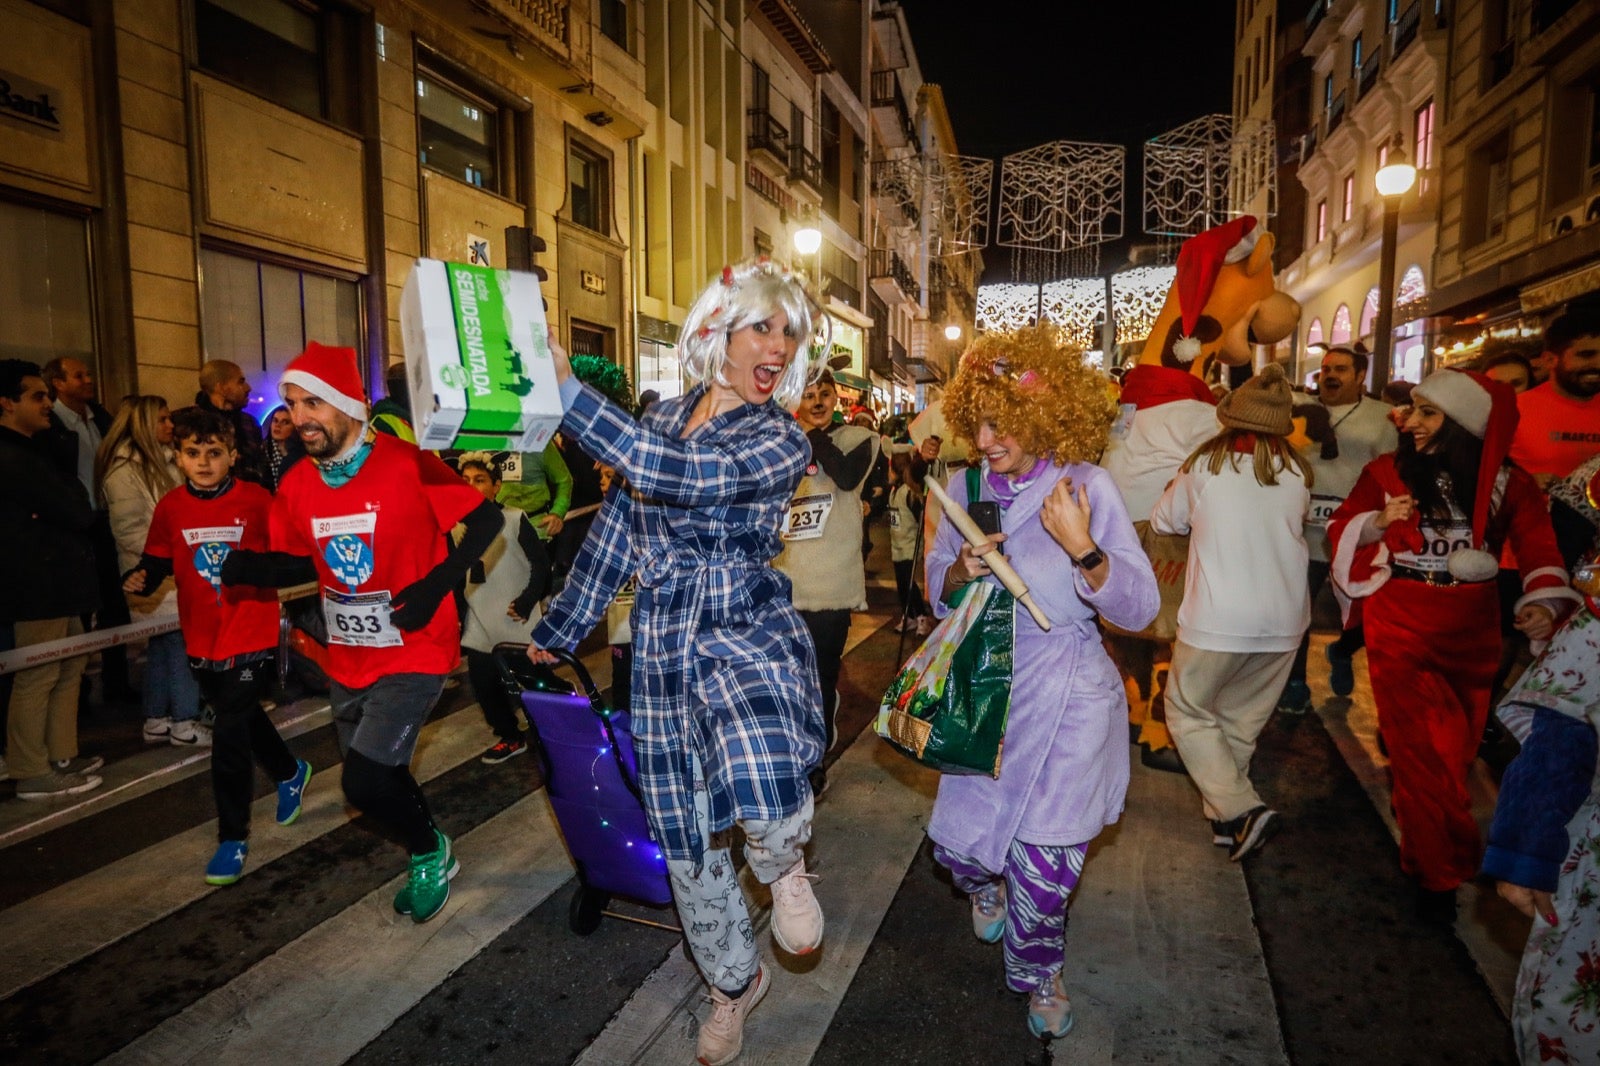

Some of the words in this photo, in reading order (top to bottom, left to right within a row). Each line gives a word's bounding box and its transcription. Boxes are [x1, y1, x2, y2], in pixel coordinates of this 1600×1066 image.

[474, 273, 489, 302] Leche
[454, 270, 492, 397] SEMIDESNATADA
[318, 522, 331, 533] 30
[791, 509, 824, 528] 237
[189, 531, 199, 541] 30
[336, 613, 382, 633] 633
